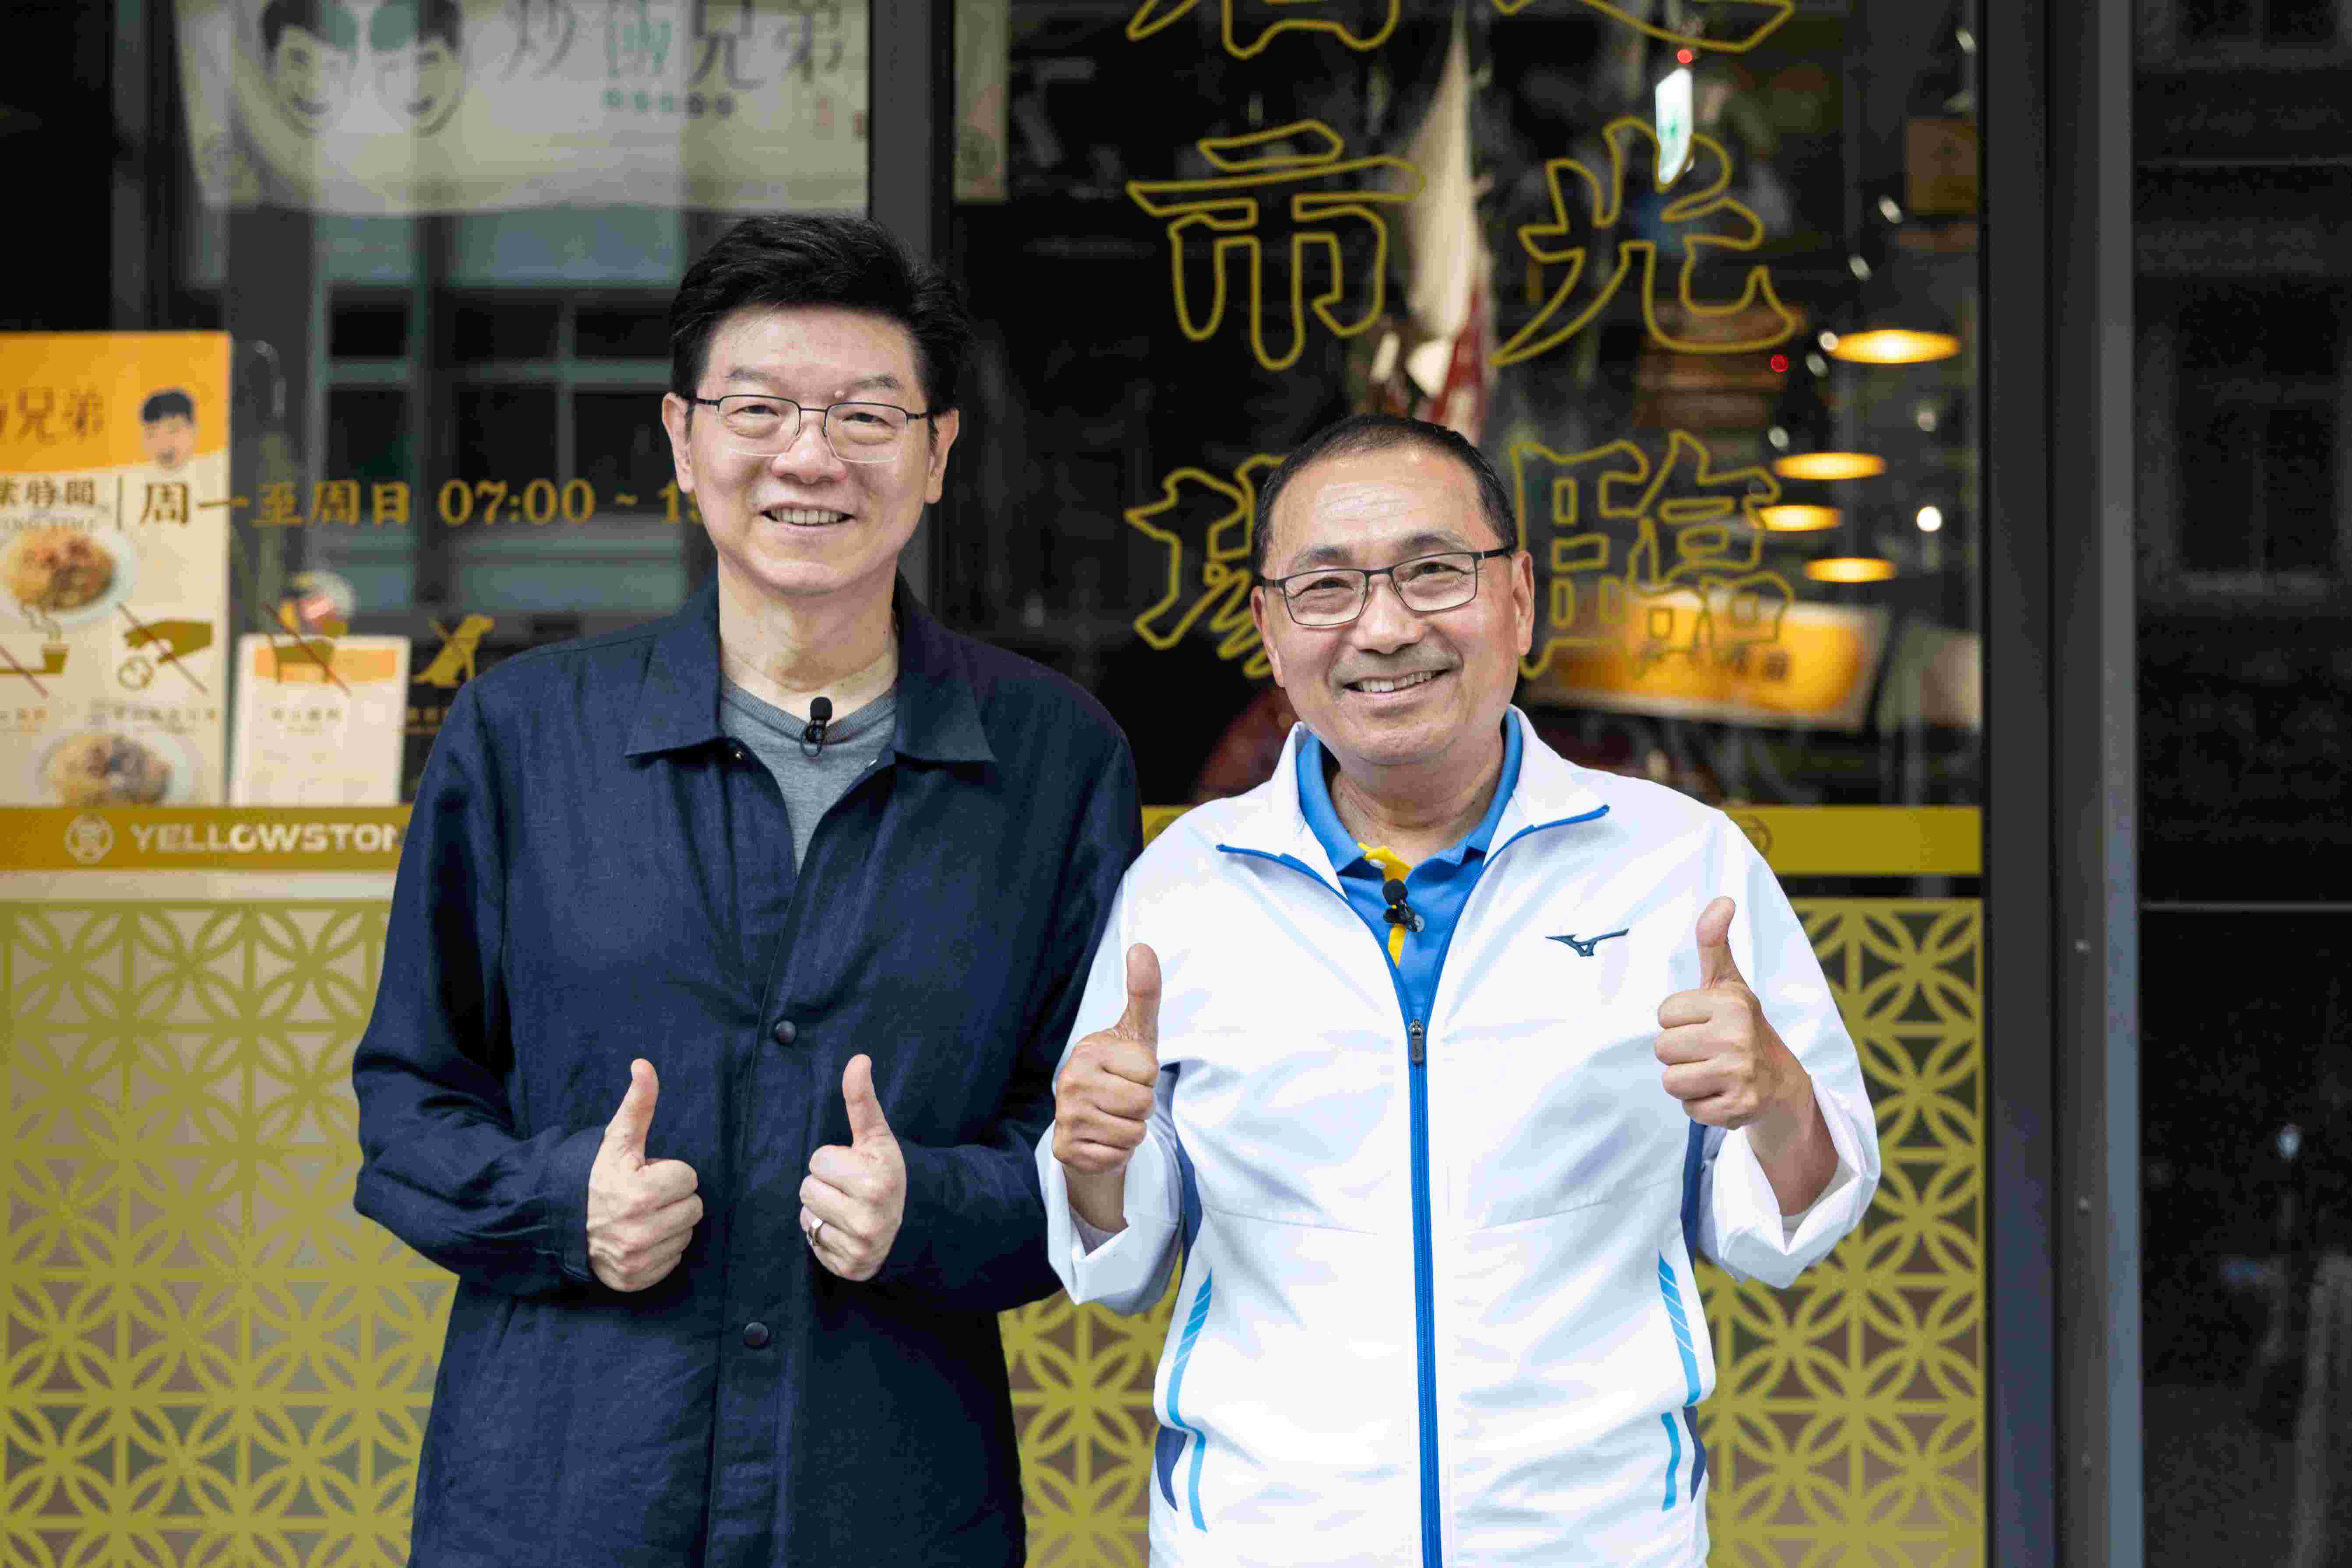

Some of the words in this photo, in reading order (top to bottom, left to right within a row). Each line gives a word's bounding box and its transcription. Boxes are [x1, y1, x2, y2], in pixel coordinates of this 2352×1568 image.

[0, 384, 104, 443] 兄弟
[140, 480, 410, 527] 周一至周日
[438, 479, 596, 525] 07:00
